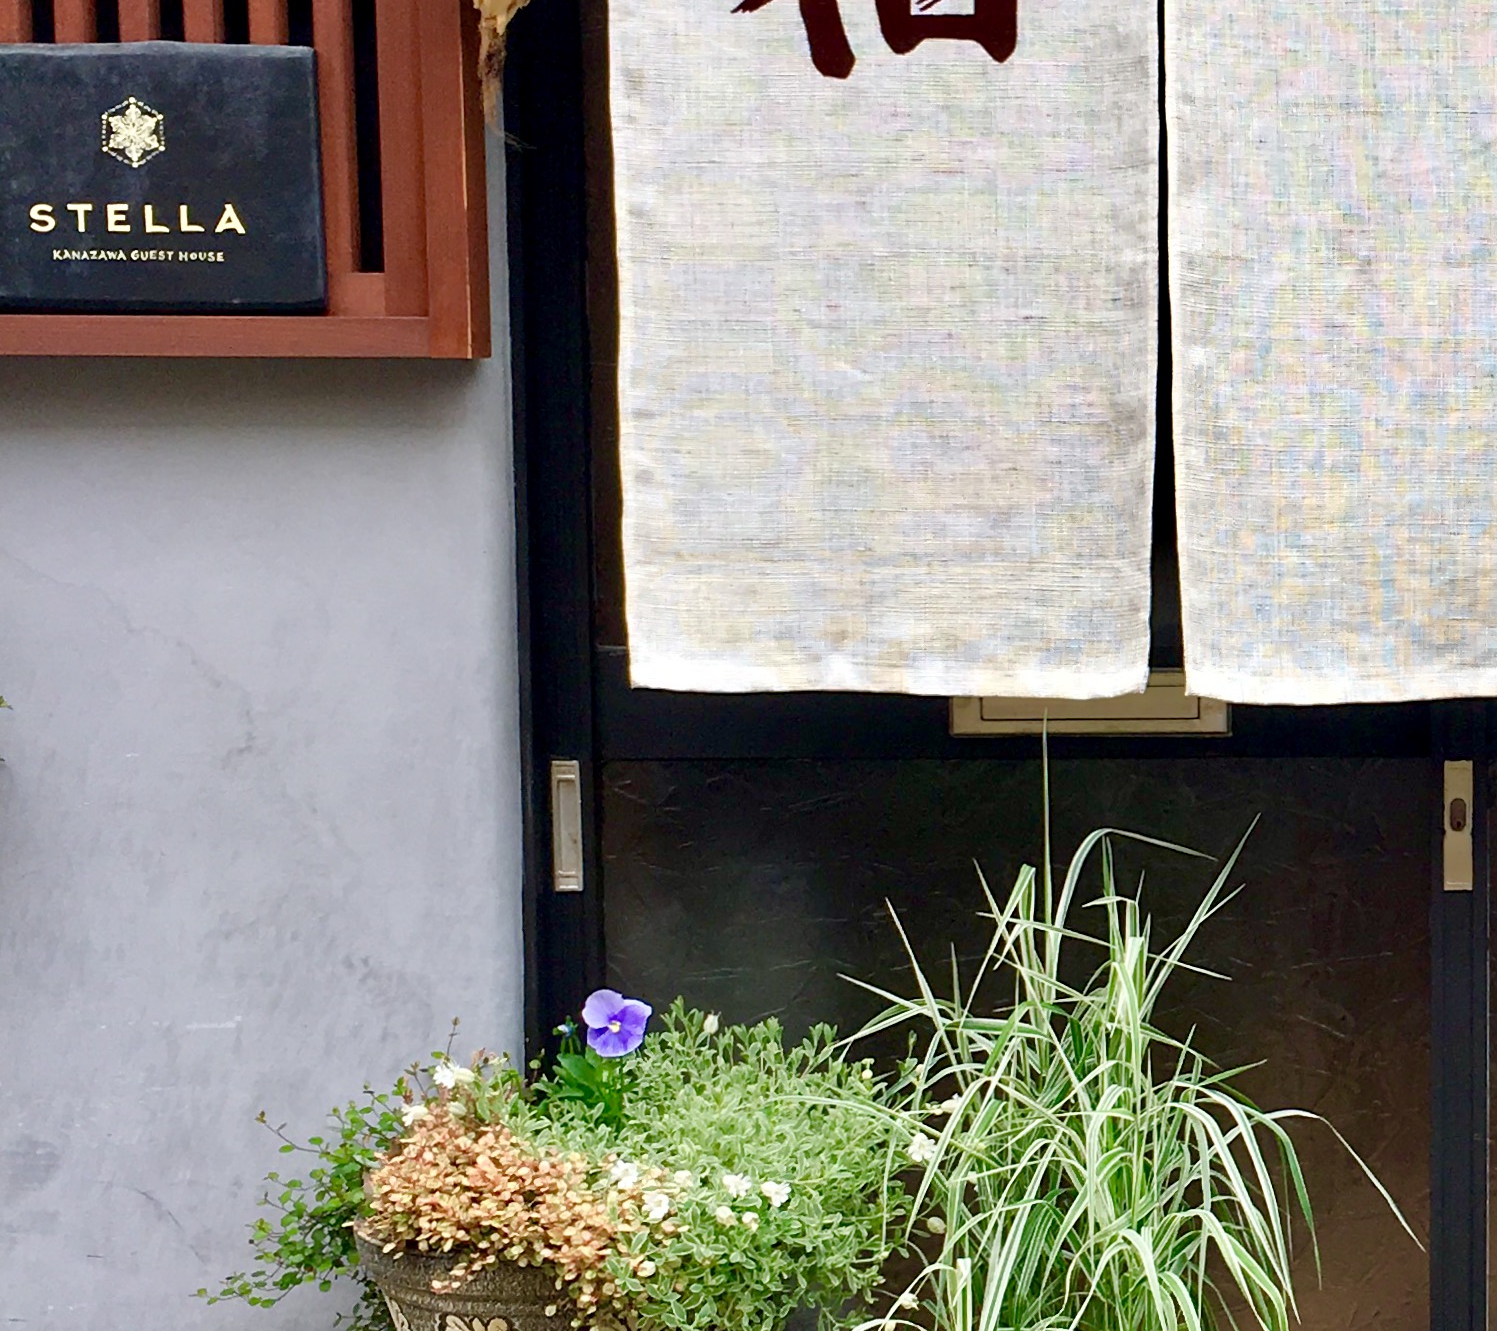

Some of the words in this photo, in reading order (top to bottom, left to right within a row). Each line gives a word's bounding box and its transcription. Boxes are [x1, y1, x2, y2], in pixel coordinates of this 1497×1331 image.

[28, 203, 246, 235] STELLA
[52, 249, 127, 262] KANAZAWA
[130, 249, 175, 262] GUEST
[178, 250, 225, 263] HOUSE
